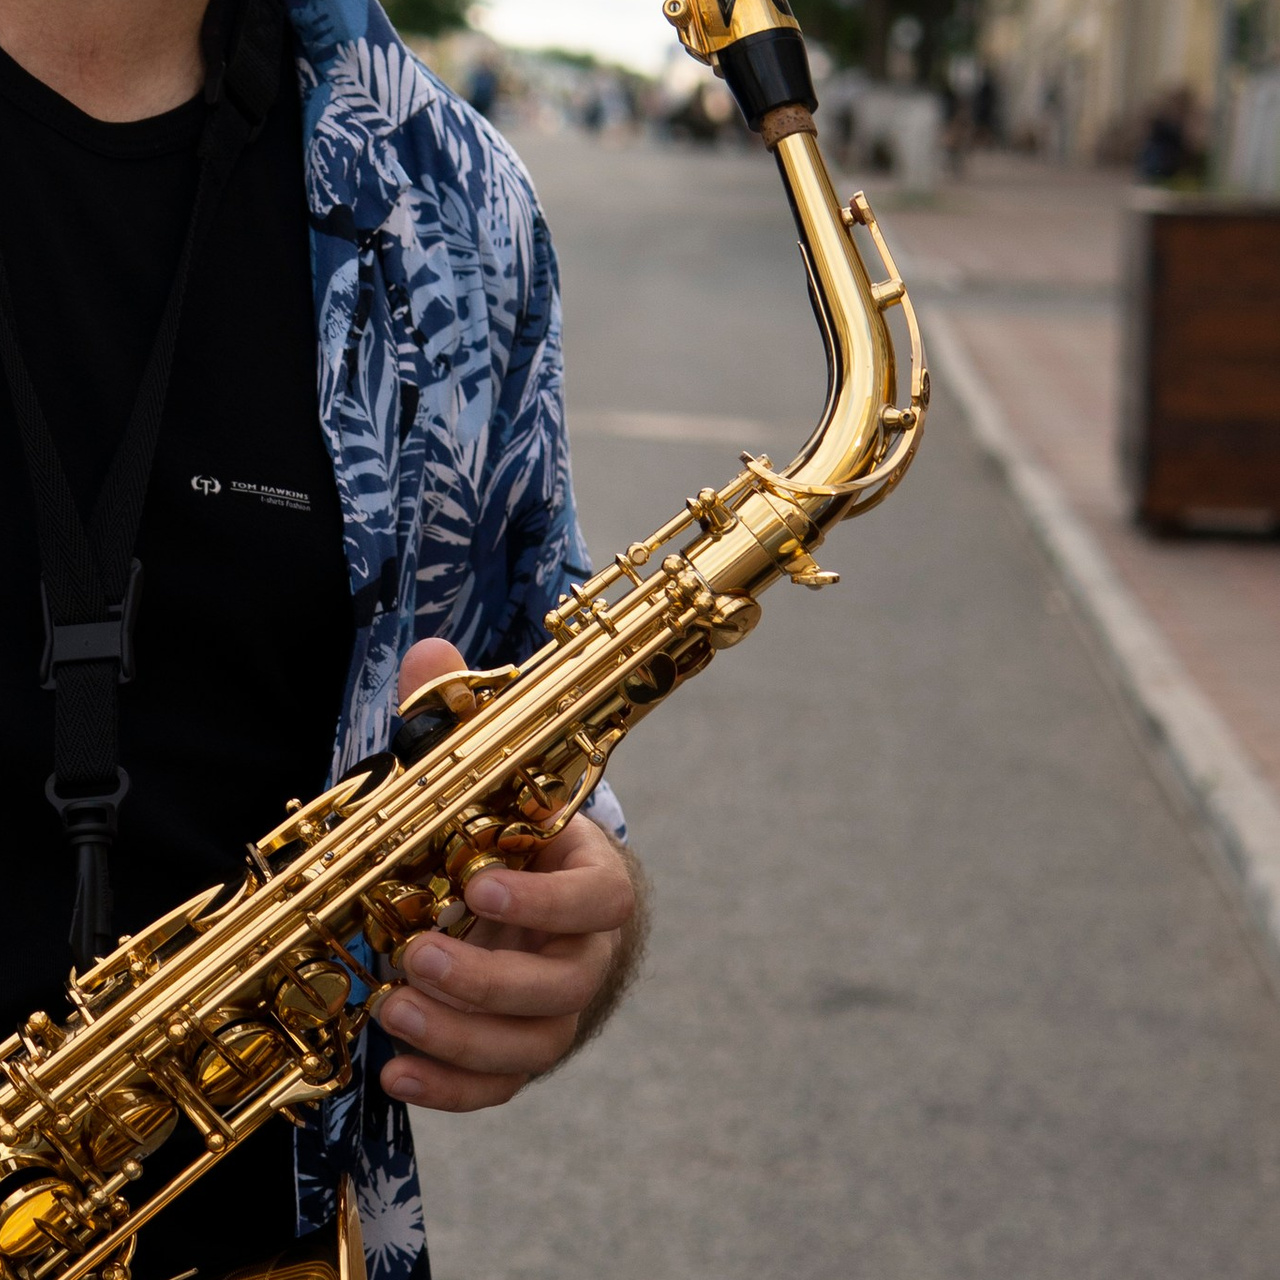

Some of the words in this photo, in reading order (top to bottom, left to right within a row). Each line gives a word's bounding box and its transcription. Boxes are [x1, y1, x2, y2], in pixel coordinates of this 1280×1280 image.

[231, 481, 257, 491] TOM
[261, 485, 308, 500] HAWKINS
[261, 496, 285, 506] t-shirts
[286, 500, 311, 511] fashion
